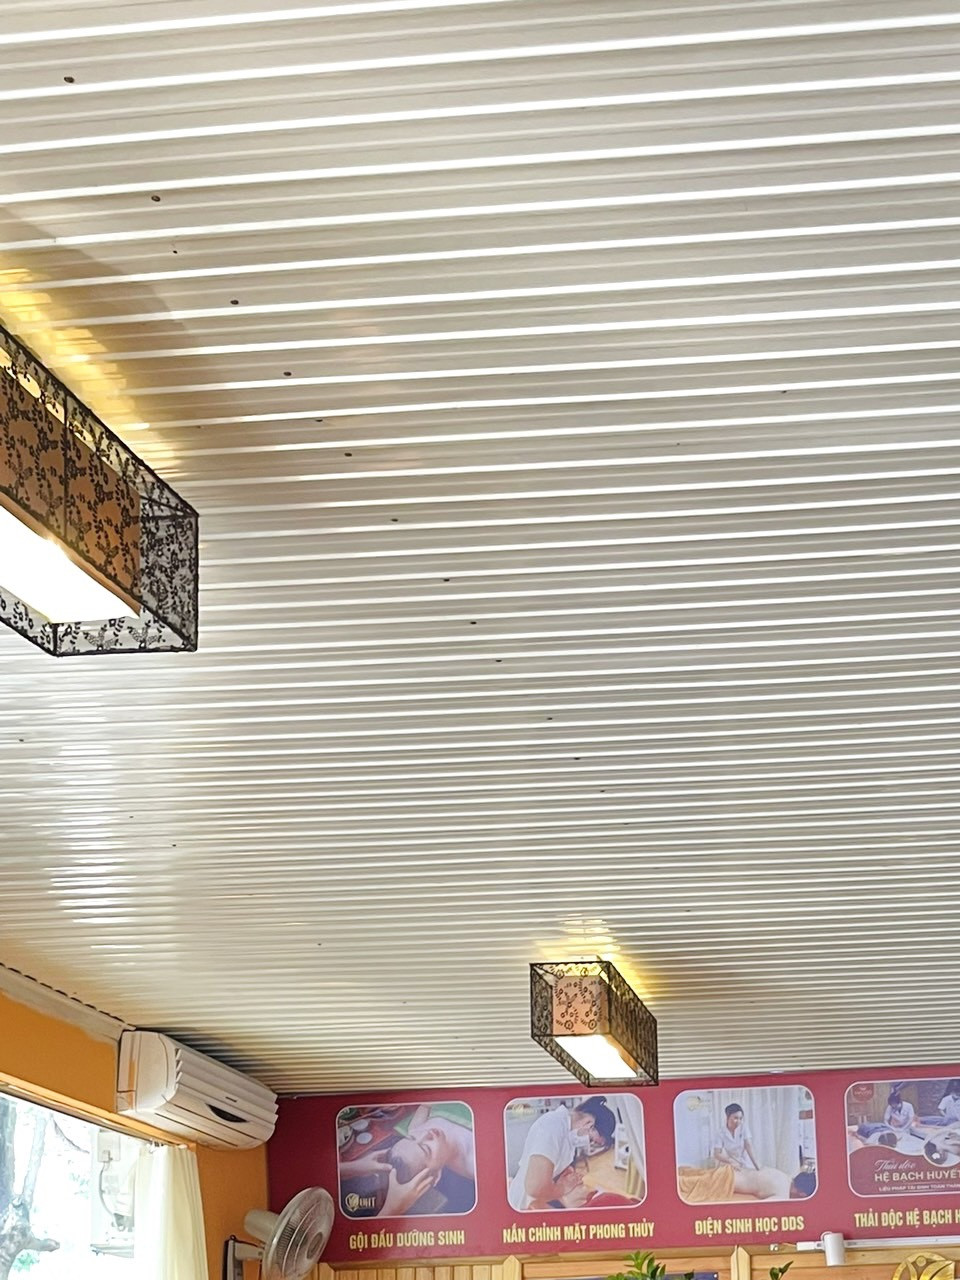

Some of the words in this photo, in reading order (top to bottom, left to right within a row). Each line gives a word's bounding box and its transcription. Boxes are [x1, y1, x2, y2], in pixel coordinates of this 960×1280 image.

[892, 1171, 924, 1182] BẠCH
[694, 1216, 722, 1238] ĐIỆN
[725, 1218, 753, 1234] SINH
[755, 1217, 778, 1235] HỌC
[781, 1215, 805, 1232] DDS
[854, 1208, 878, 1228] THẢI
[881, 1208, 903, 1229] ĐỘC
[906, 1207, 920, 1228] HỆ
[922, 1209, 952, 1228] BẠCH
[349, 1231, 368, 1252] GỘI
[397, 1228, 434, 1247] DƯỠNG
[437, 1230, 465, 1246] SINH
[528, 1222, 561, 1242] CHỈNH
[564, 1222, 587, 1243] MẶT
[589, 1223, 626, 1240] PHONG
[627, 1217, 655, 1237] THỦY
